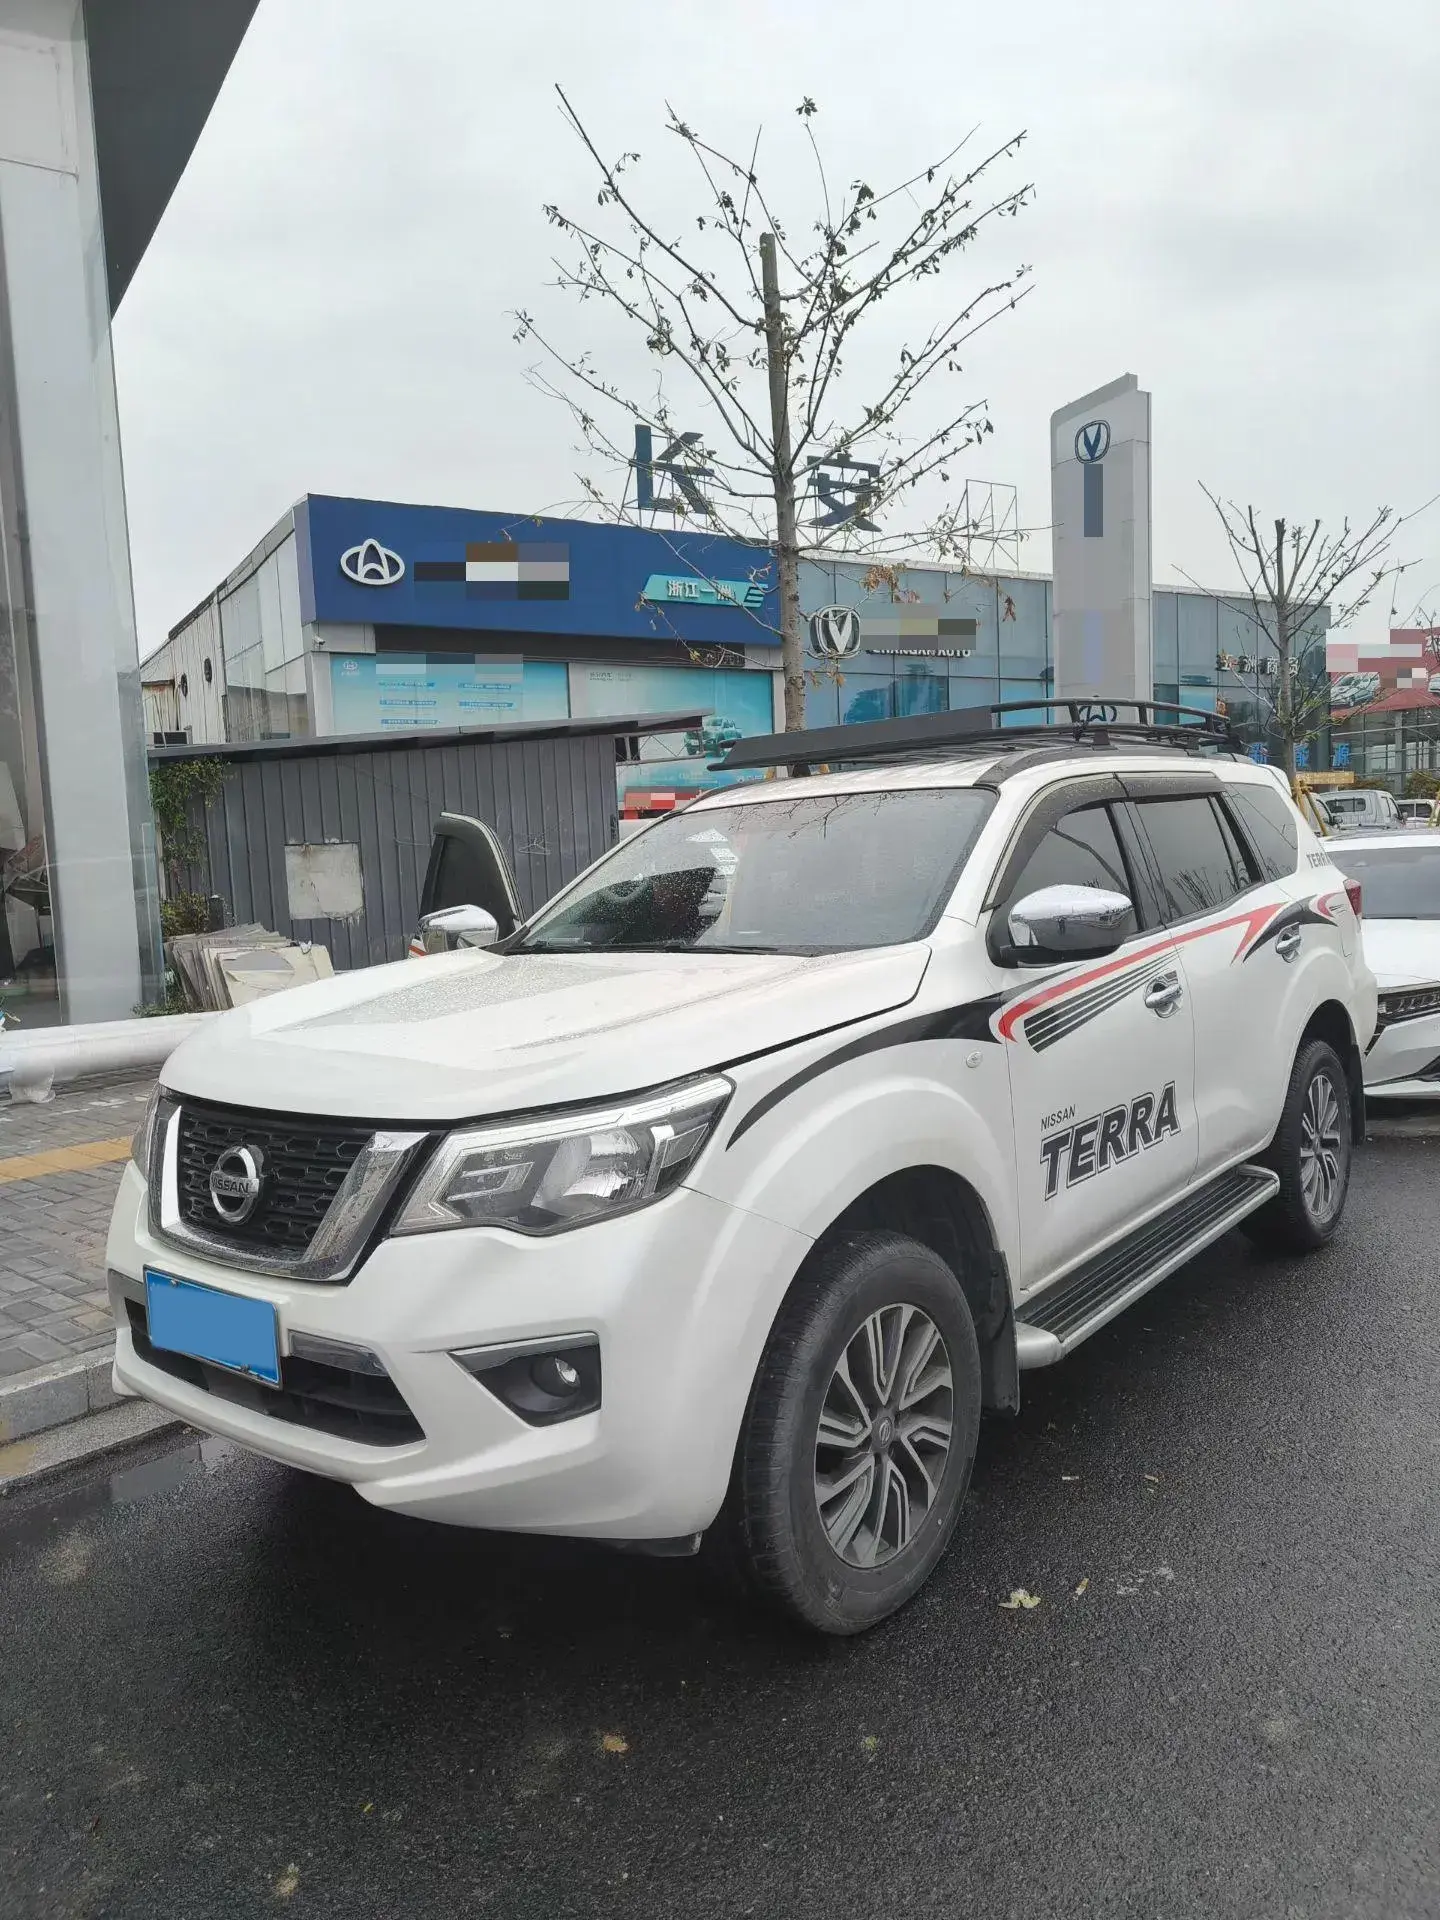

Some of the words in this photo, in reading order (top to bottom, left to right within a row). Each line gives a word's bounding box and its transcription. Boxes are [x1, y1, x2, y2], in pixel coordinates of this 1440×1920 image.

[1040, 1104, 1076, 1131] NISSAN
[1040, 1080, 1181, 1201] TERRA
[211, 1173, 250, 1194] NISSAN
